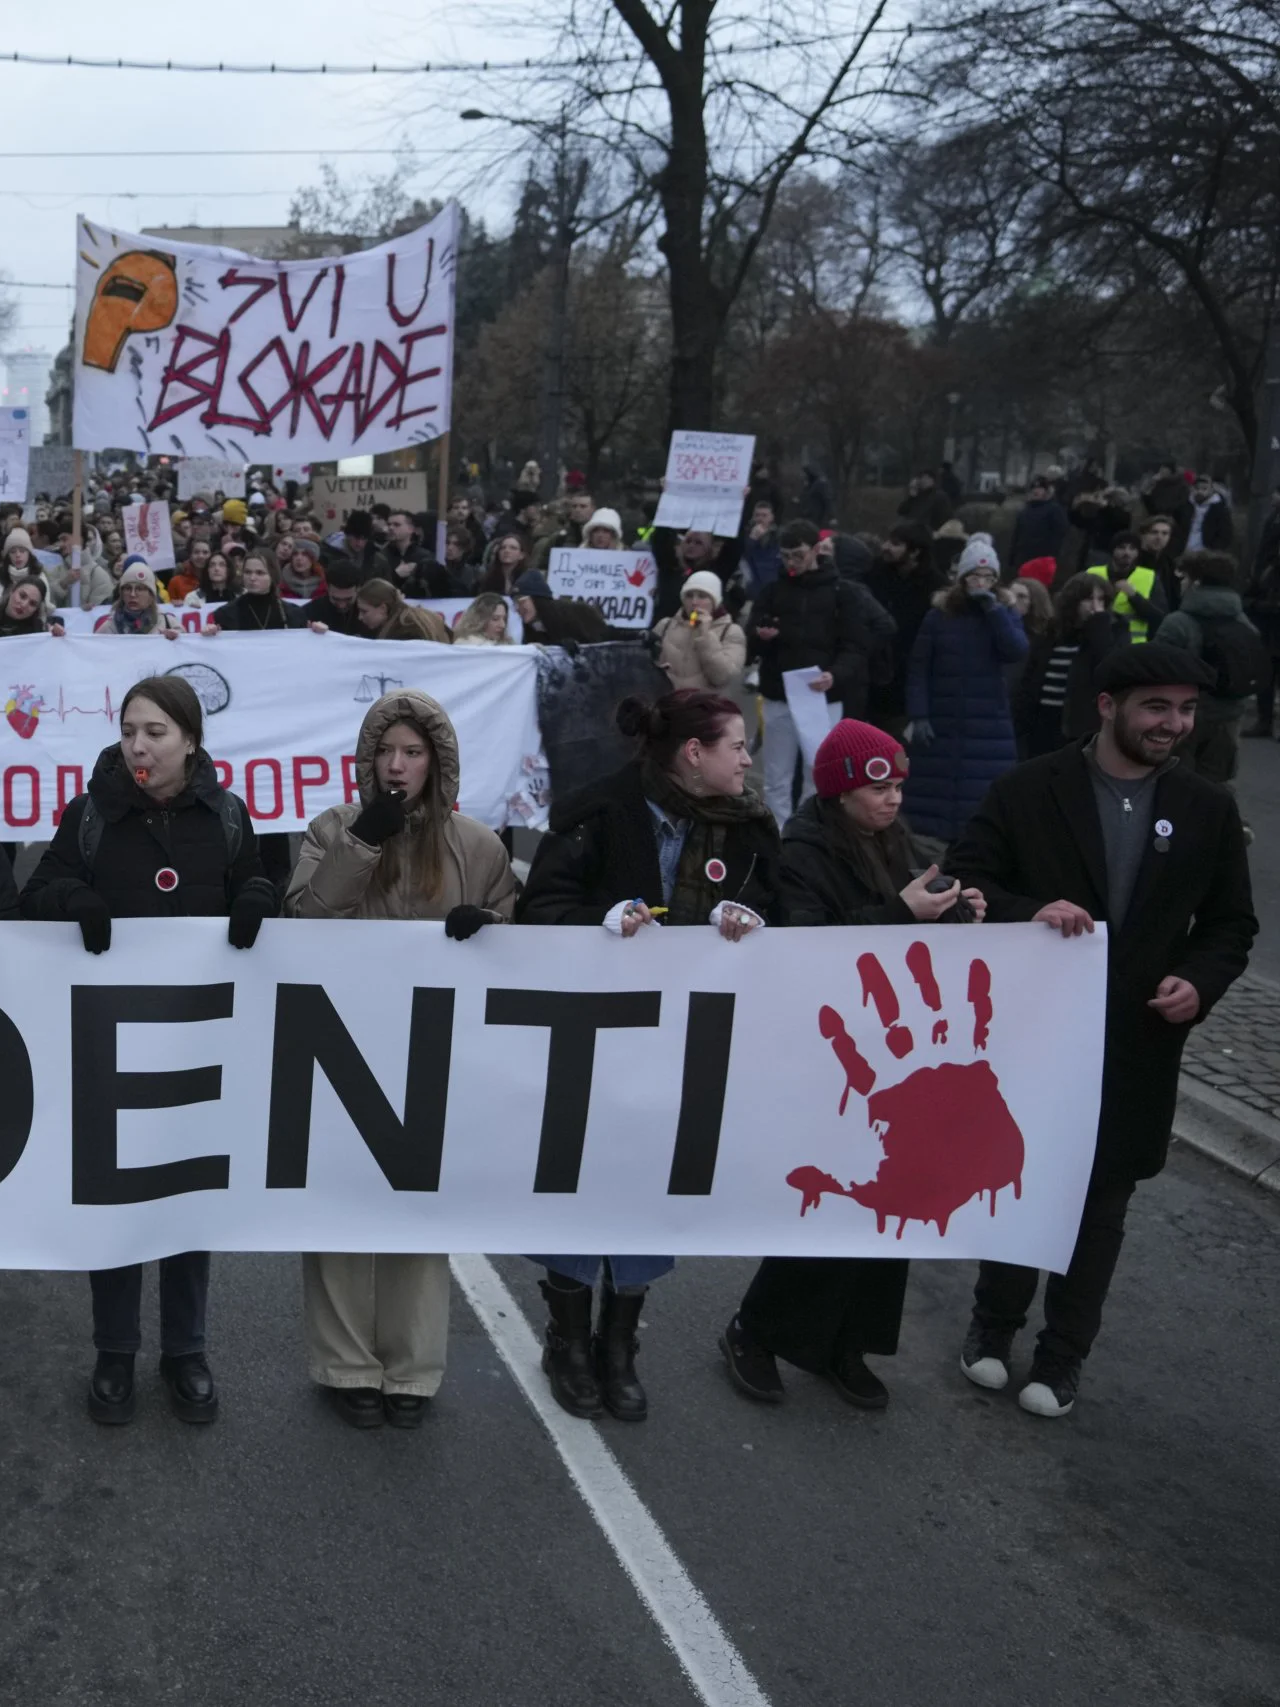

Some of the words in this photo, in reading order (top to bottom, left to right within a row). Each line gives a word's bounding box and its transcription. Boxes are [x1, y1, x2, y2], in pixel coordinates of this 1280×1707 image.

[218, 263, 345, 339] SVI
[385, 238, 435, 327] U
[147, 324, 447, 445] BLOKADE
[675, 467, 740, 482] SOFTVER
[324, 477, 408, 493] VETERINARI
[357, 494, 376, 507] NA
